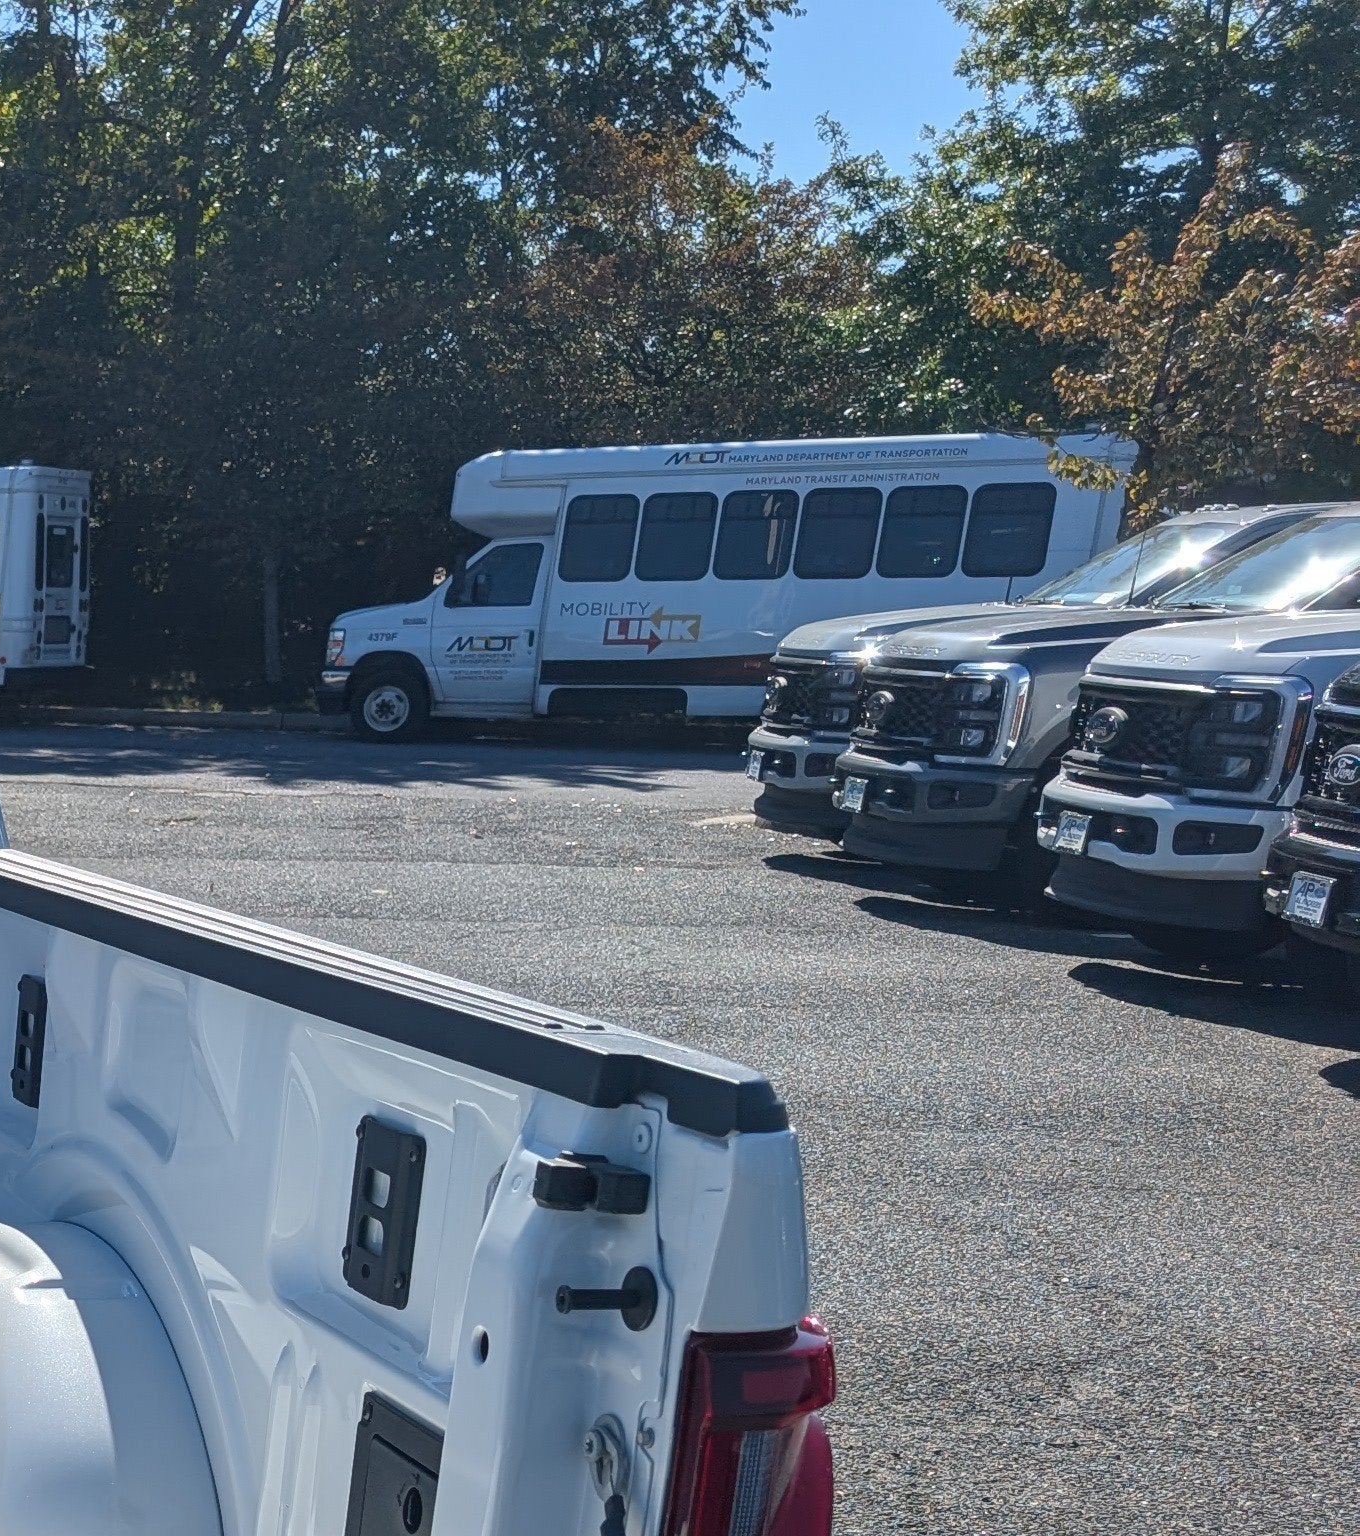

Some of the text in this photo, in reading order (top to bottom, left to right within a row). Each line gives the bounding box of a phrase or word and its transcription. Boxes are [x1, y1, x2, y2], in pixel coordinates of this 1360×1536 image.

[729, 453, 783, 463] MARYLAND
[786, 451, 854, 462] DEPARTMENT
[857, 450, 872, 459] OF
[874, 448, 968, 459] TRANSPORTATION
[745, 472, 940, 486] MARYLAND TRANSIT ADMINISTRATION
[560, 602, 650, 617] MOBILITY
[606, 619, 699, 640] LINK
[1334, 757, 1359, 780] Ford
